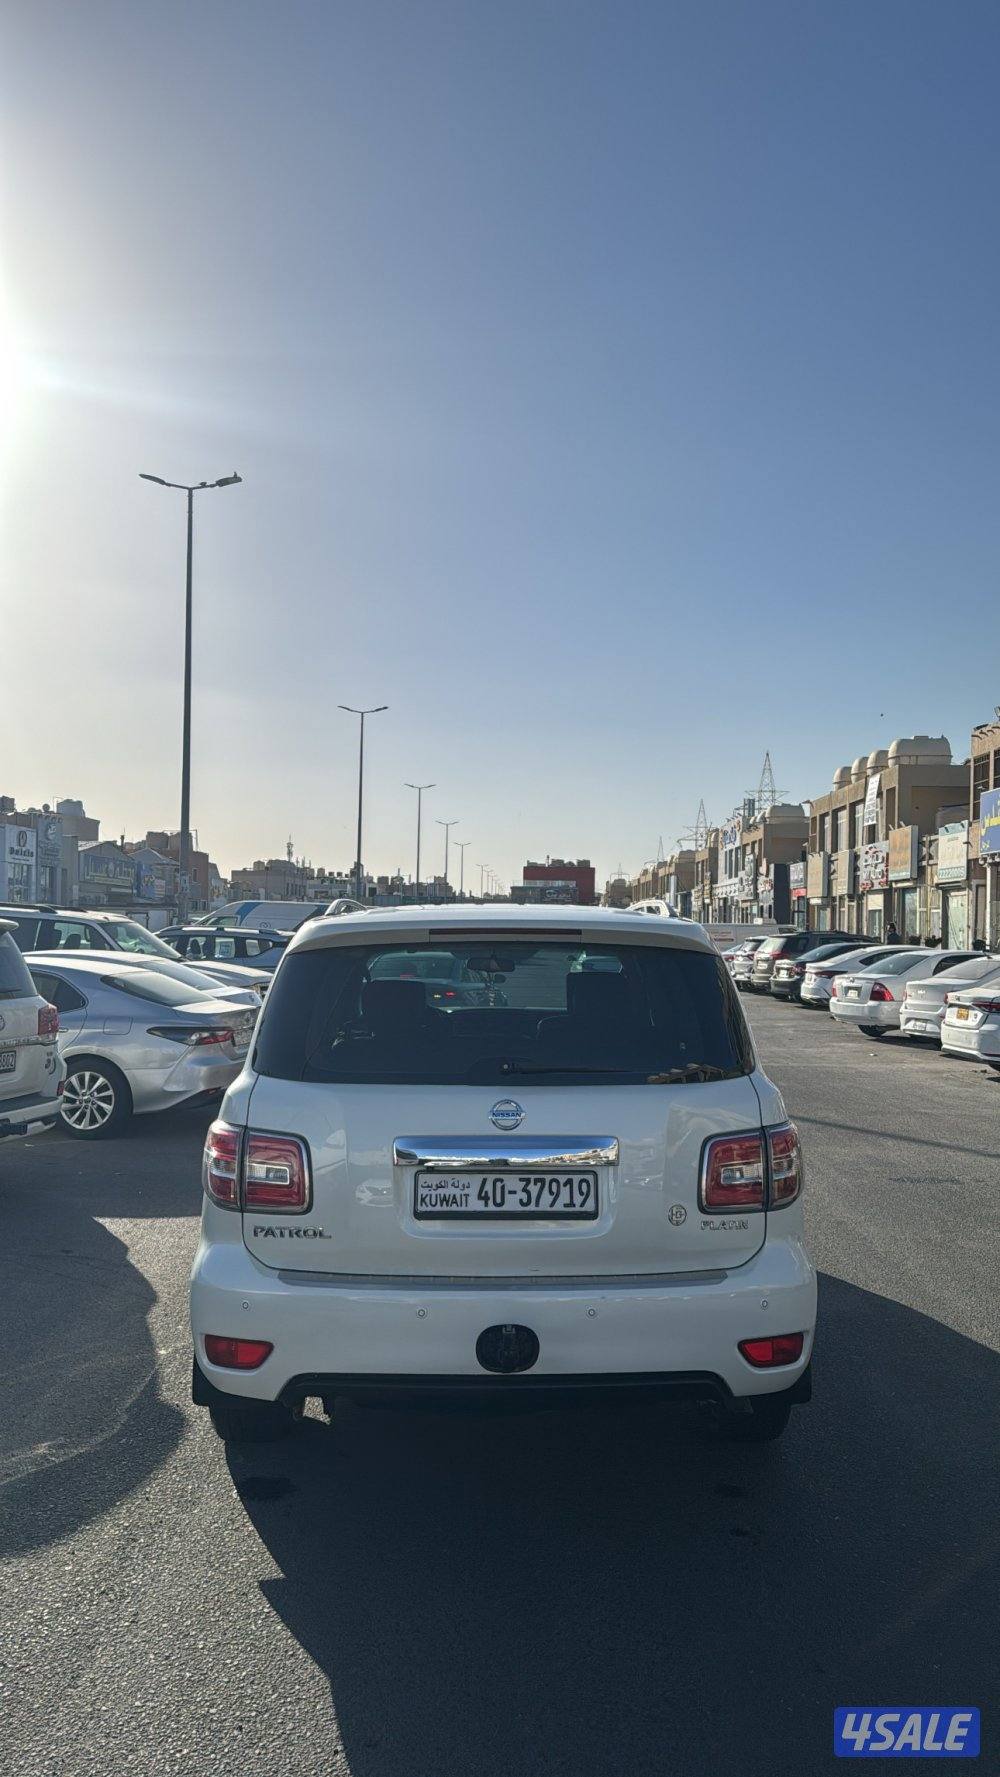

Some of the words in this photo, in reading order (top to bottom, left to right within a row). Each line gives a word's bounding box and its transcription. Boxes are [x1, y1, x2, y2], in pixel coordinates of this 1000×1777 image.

[421, 1180, 448, 1191] الكويت
[451, 1178, 470, 1190] دولة
[477, 1178, 591, 1208] 40-37919
[420, 1194, 470, 1208] KUWAIT
[253, 1225, 332, 1239] PATROL
